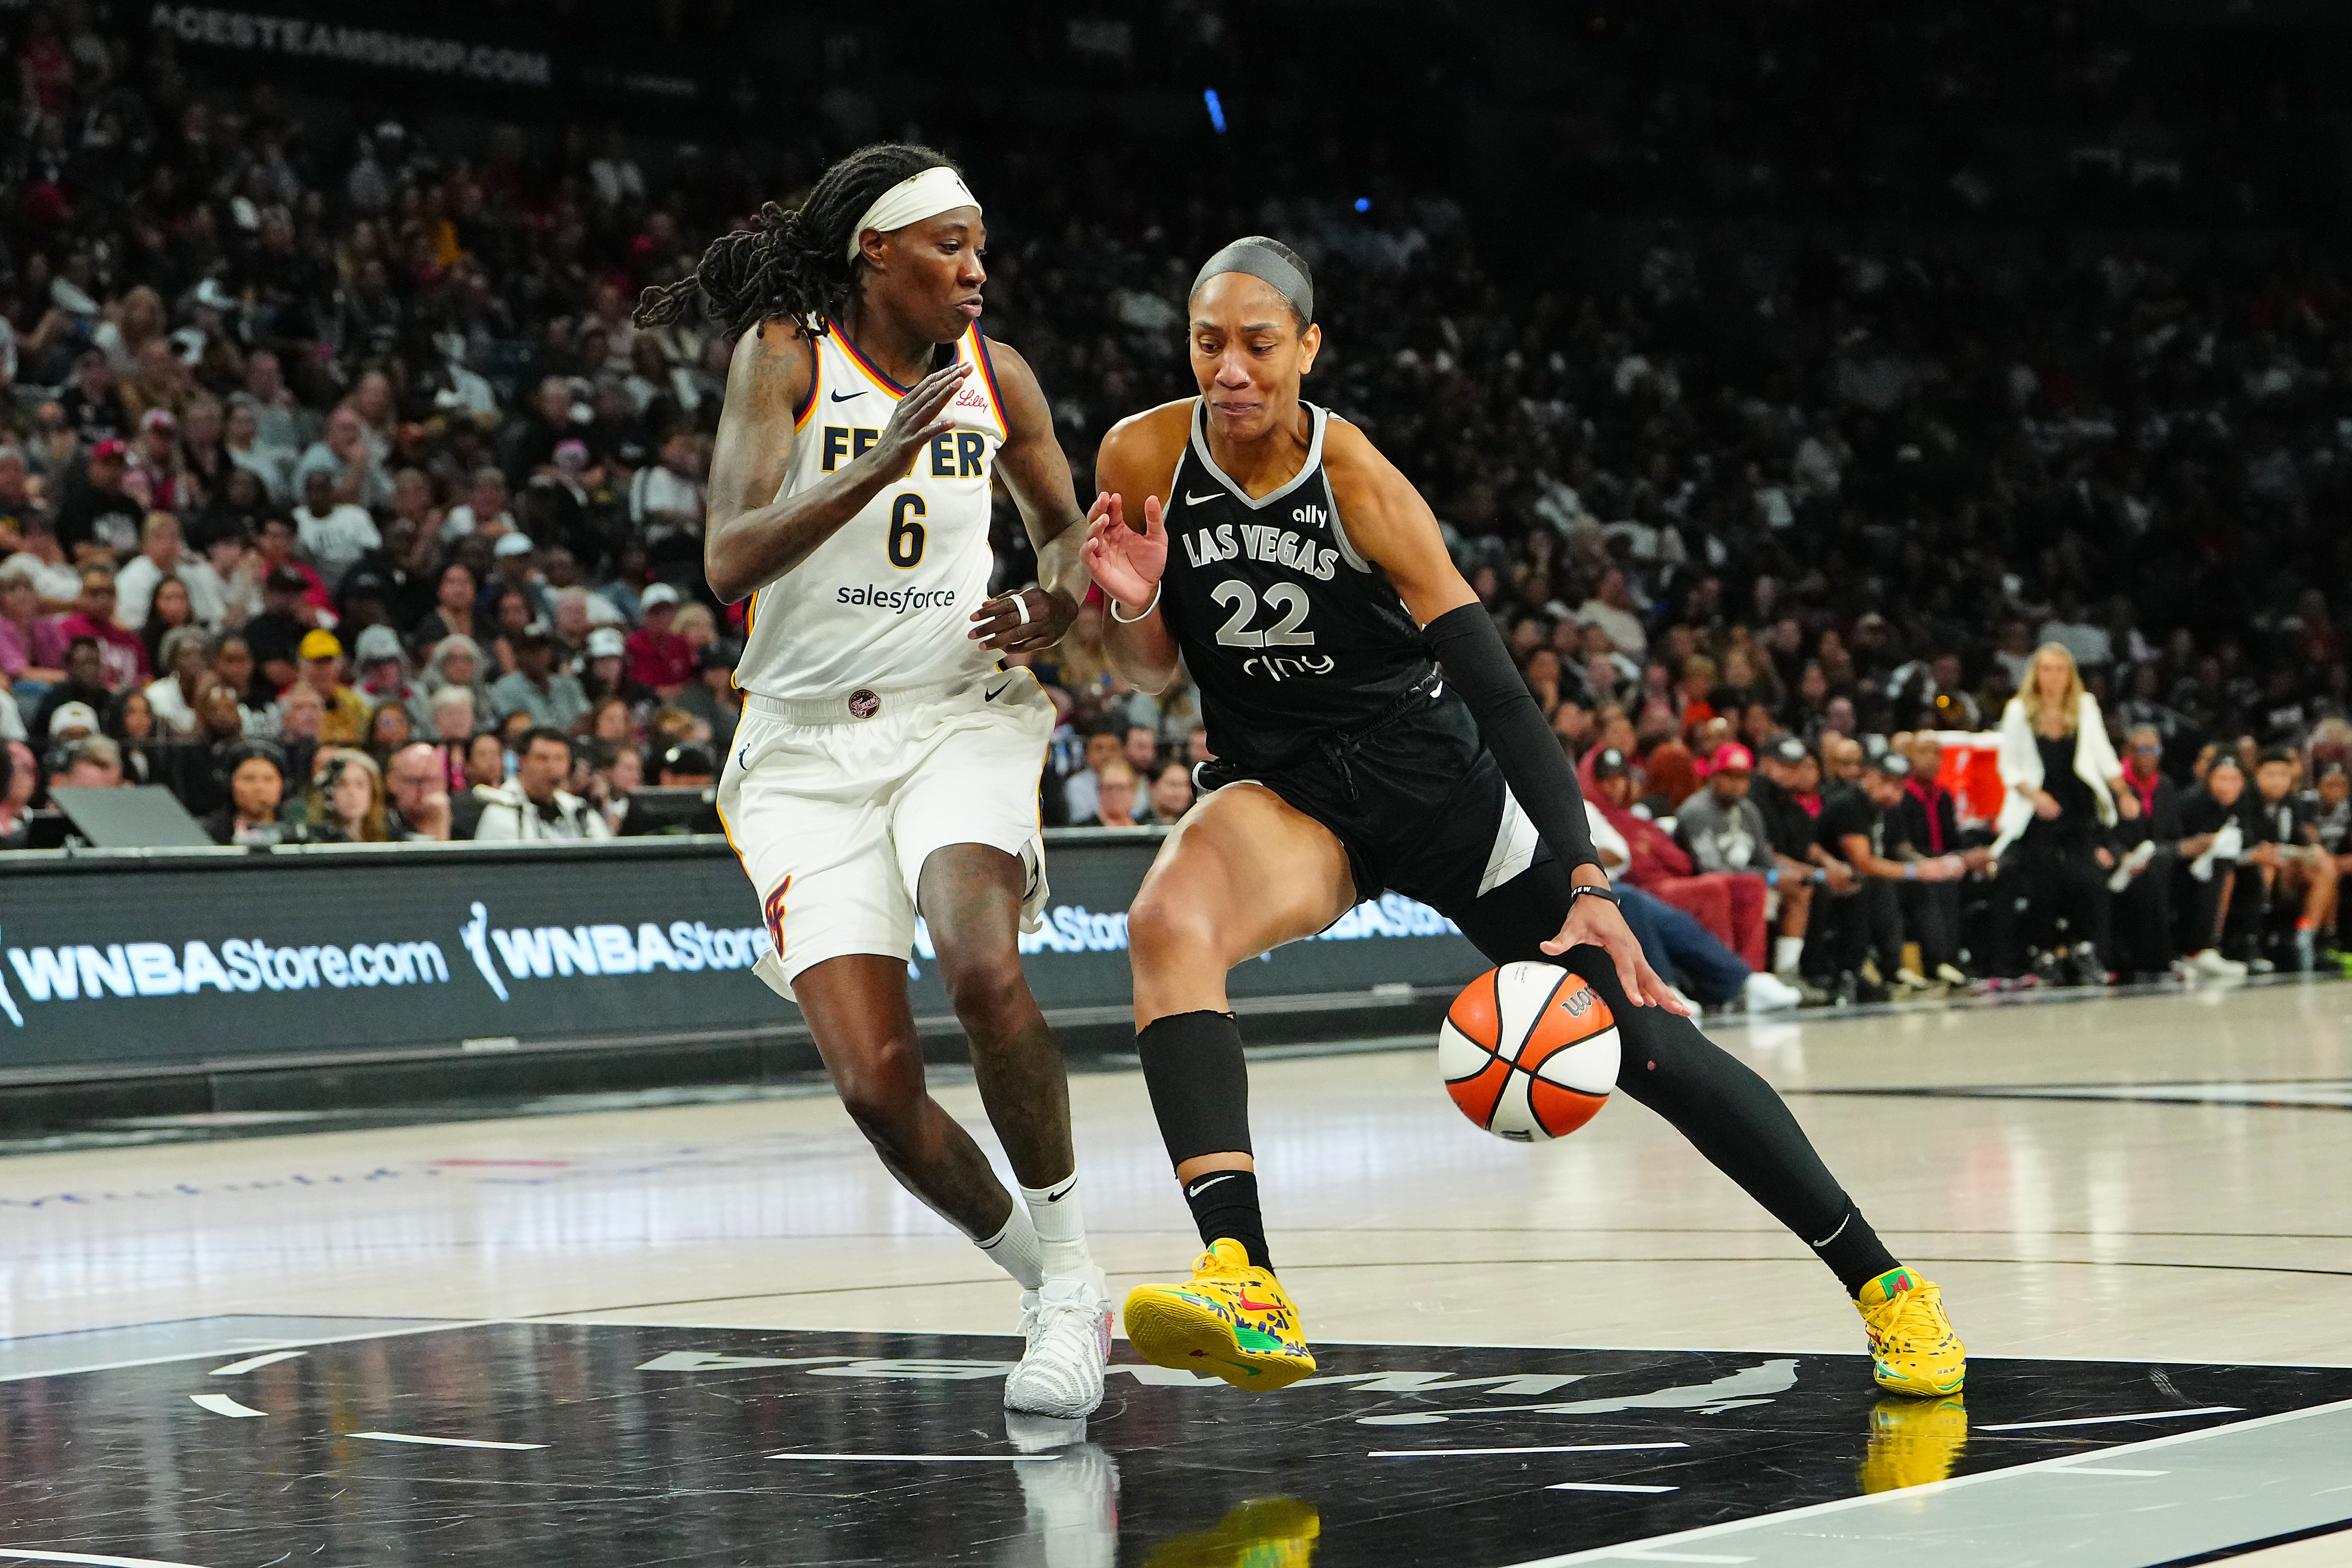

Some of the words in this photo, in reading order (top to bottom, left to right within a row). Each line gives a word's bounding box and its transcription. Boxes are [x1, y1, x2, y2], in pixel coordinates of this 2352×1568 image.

[956, 389, 989, 413] Lilly
[820, 425, 985, 478] FEER
[887, 493, 927, 569] 6
[1292, 505, 1327, 528] ally
[1182, 524, 1239, 568] LAS
[1240, 524, 1339, 581] VEGAS
[836, 584, 955, 614] salesforce
[1210, 580, 1315, 648] 22
[7, 938, 450, 1001] WNBAStore.com
